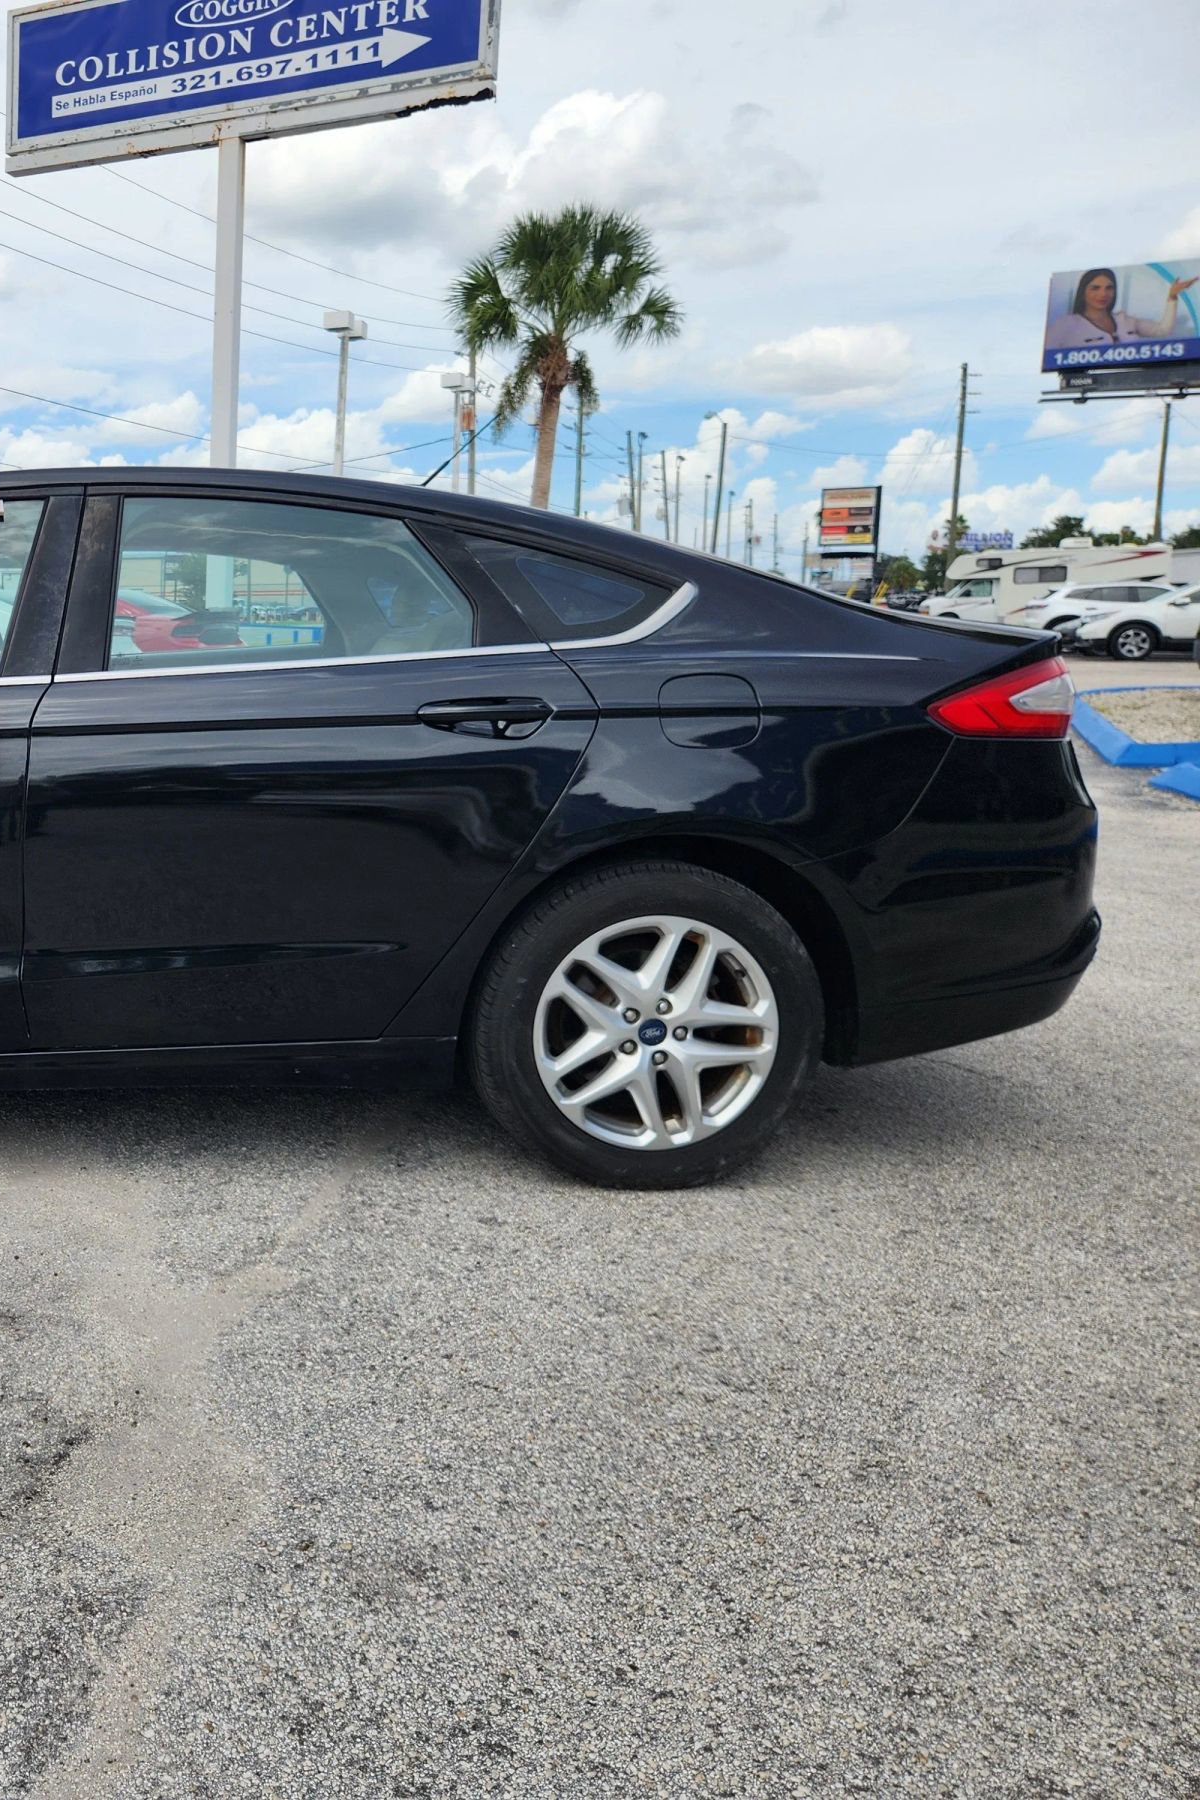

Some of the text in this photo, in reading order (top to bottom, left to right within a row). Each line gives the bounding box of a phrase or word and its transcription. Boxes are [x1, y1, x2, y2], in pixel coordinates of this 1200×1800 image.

[55, 0, 431, 87] COLLISION CENTER
[55, 42, 380, 111] Se Habla Español 321.697.1111
[1054, 343, 1185, 365] 1.800.400.5143
